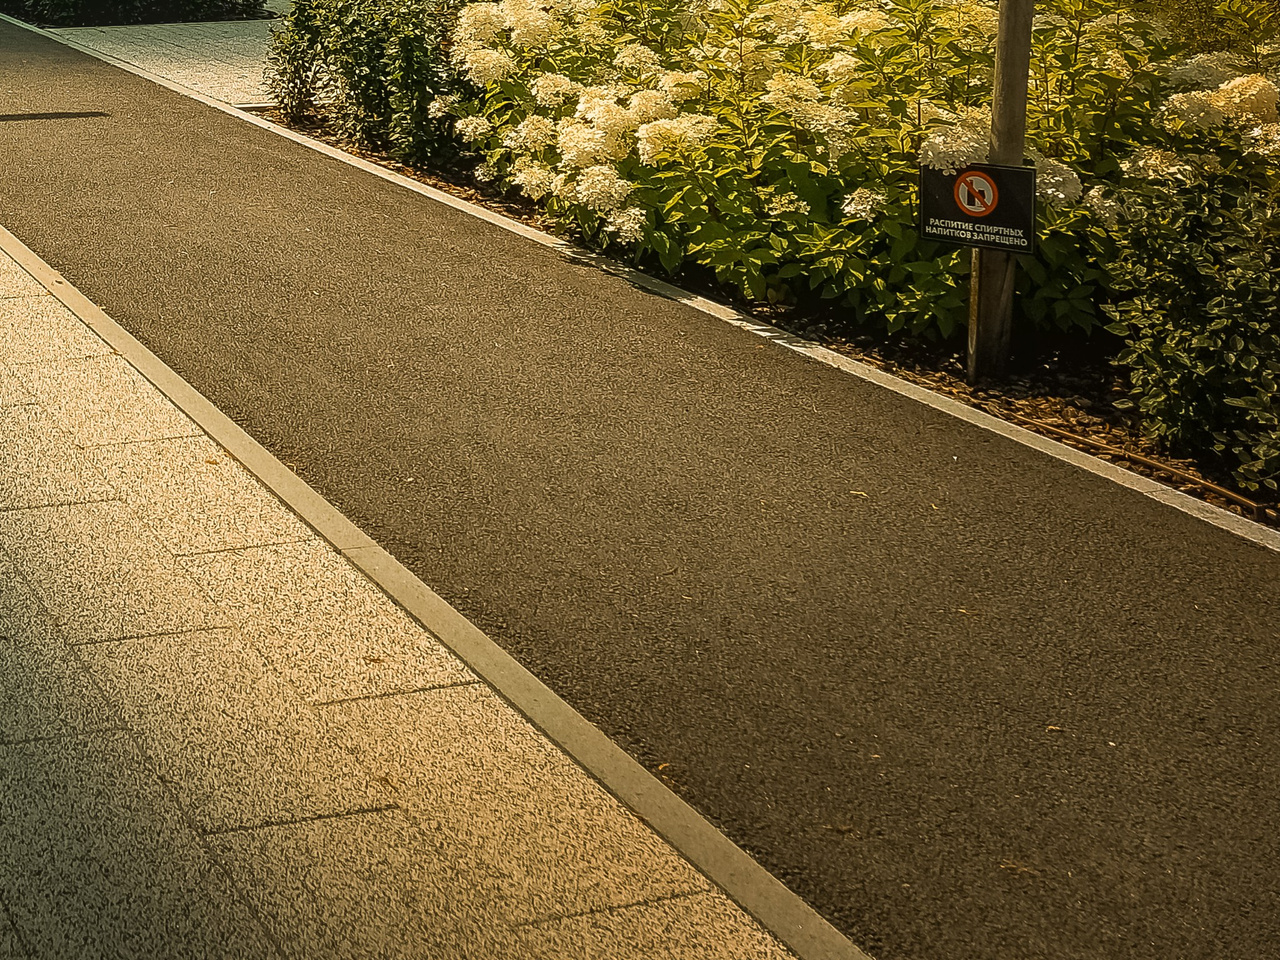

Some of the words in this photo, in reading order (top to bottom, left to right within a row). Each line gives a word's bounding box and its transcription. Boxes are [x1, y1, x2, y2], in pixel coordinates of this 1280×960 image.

[925, 226, 972, 239] НАПИТКОВ
[973, 233, 1028, 246] ЗАПРЕЩЕНО
[929, 218, 973, 231] РАСПИТИЕ
[974, 223, 1024, 237] СПИРТНЫХ
